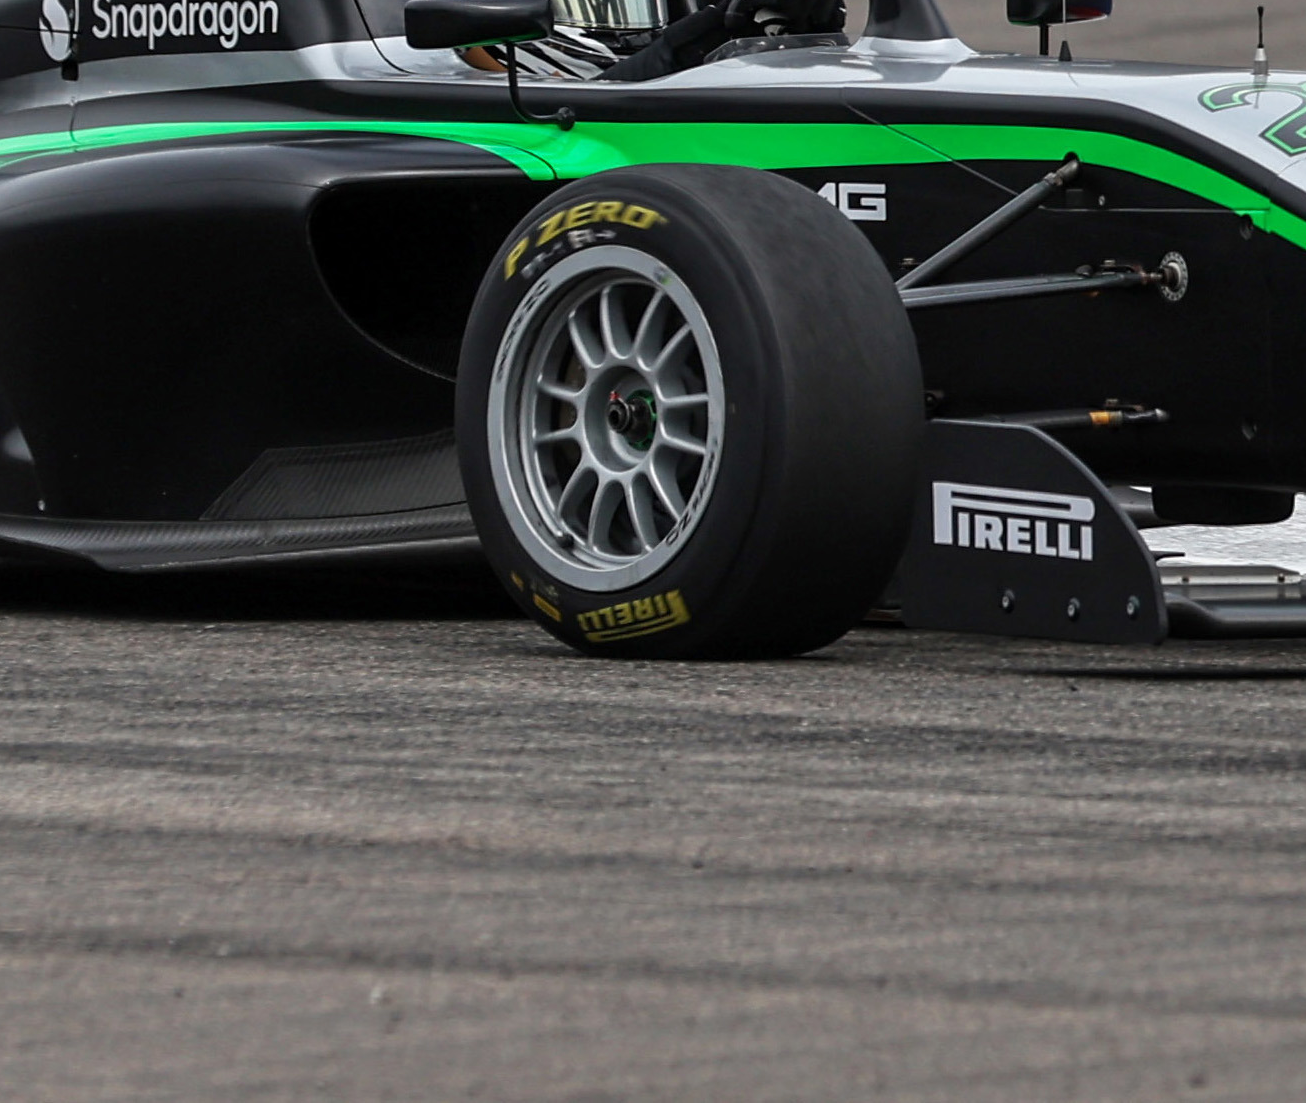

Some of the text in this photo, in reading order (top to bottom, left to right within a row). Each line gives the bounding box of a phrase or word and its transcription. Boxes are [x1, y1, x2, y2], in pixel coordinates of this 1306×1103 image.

[535, 201, 662, 247] ZERO
[932, 481, 1095, 561] PIRELLI
[577, 588, 691, 643] PIRELLI
